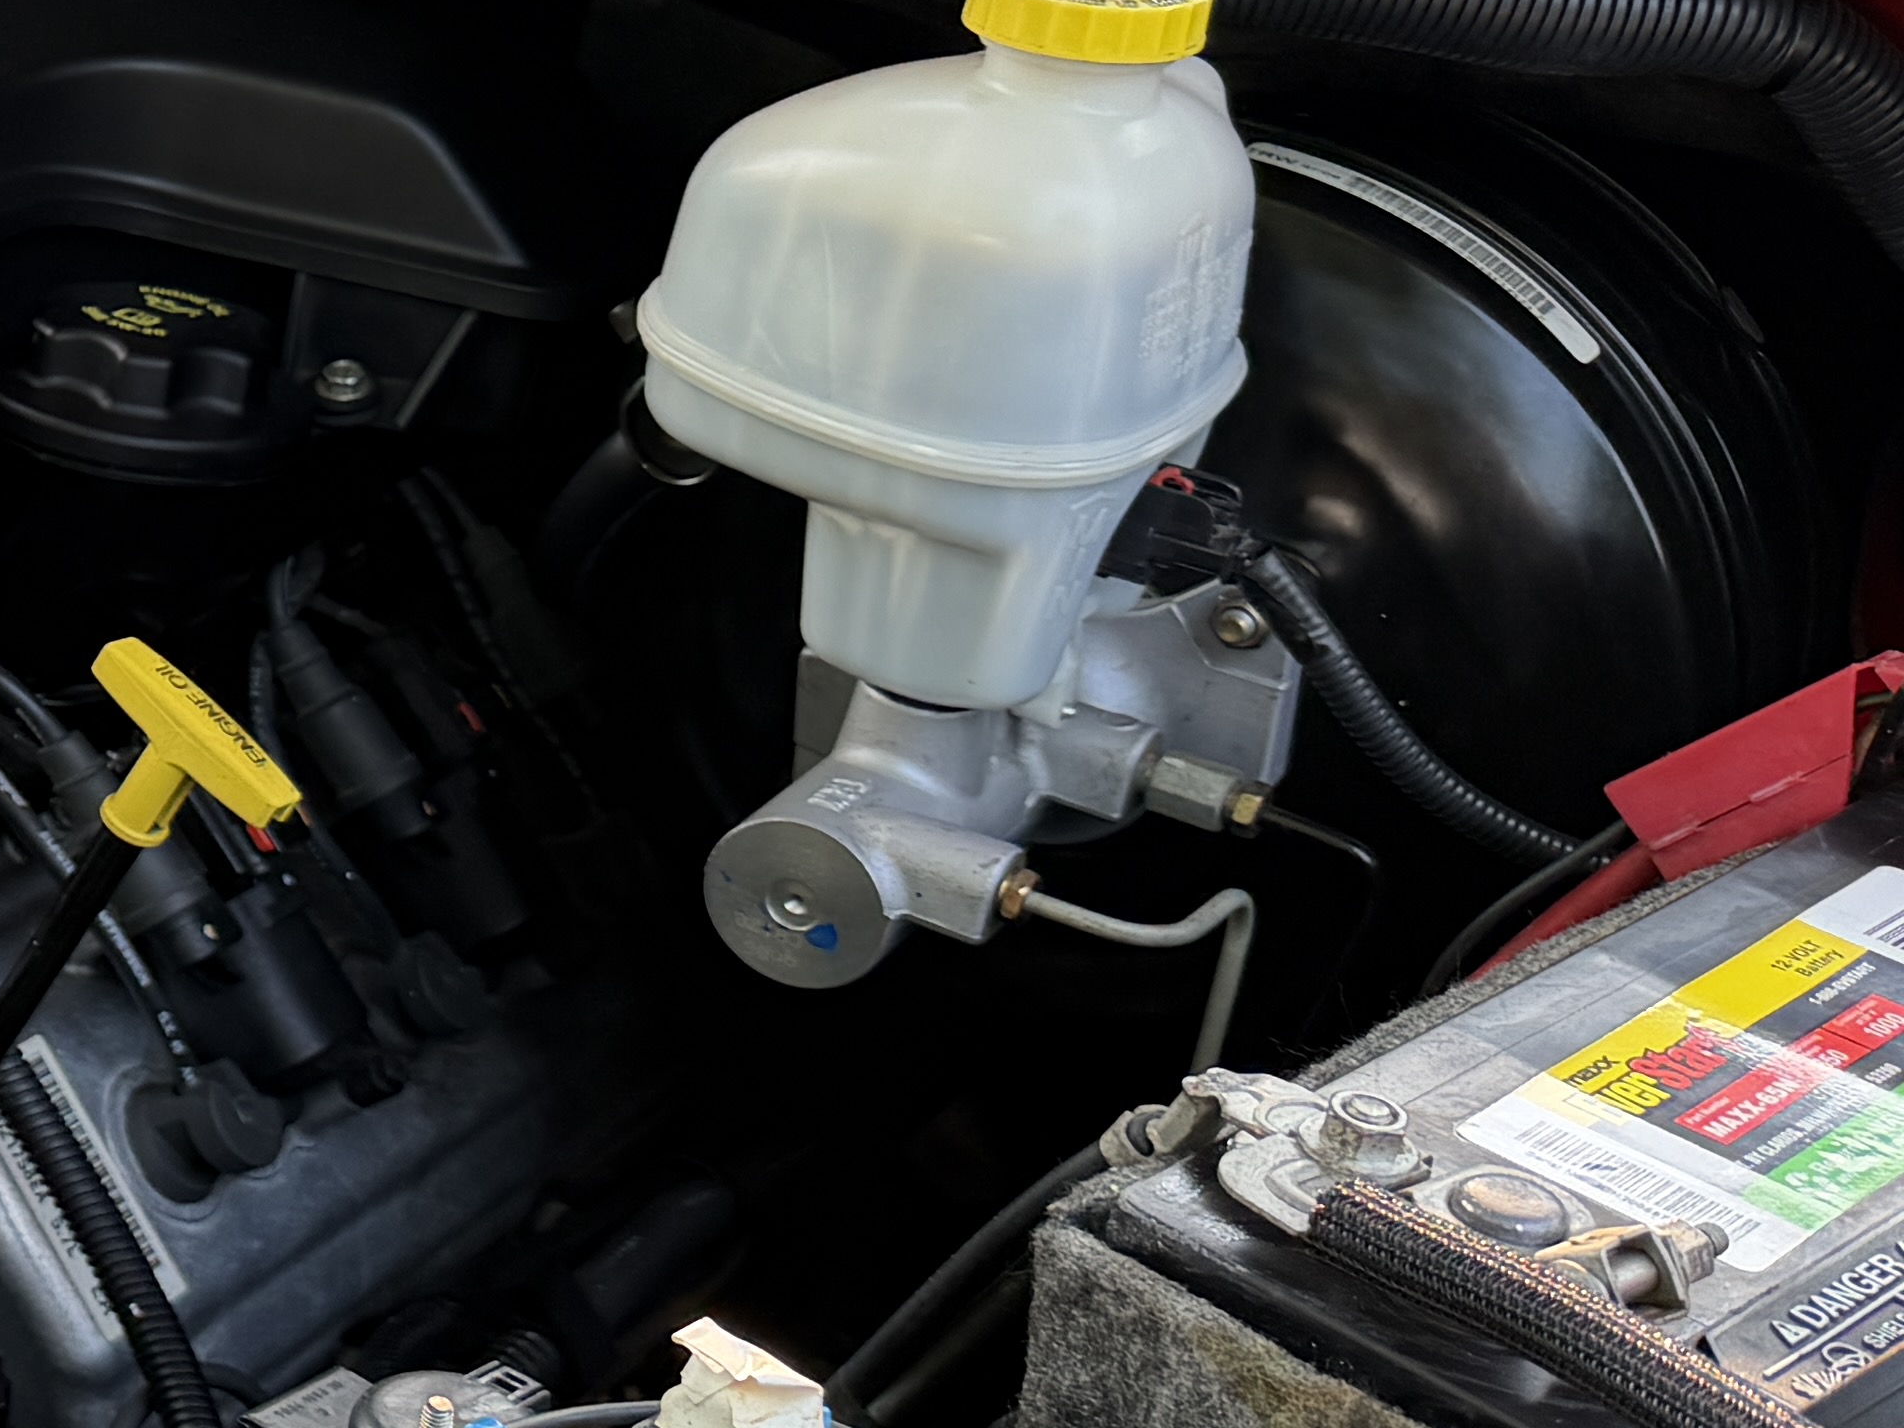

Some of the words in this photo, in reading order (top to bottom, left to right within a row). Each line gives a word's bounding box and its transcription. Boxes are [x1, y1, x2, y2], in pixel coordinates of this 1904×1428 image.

[155, 661, 189, 690] OIL
[186, 692, 267, 768] ENGINE
[1770, 939, 1825, 973] 12-VOLT
[1794, 948, 1846, 978] Battery
[1864, 1012, 1904, 1038] 1000
[1789, 1254, 1904, 1329] DANGER
